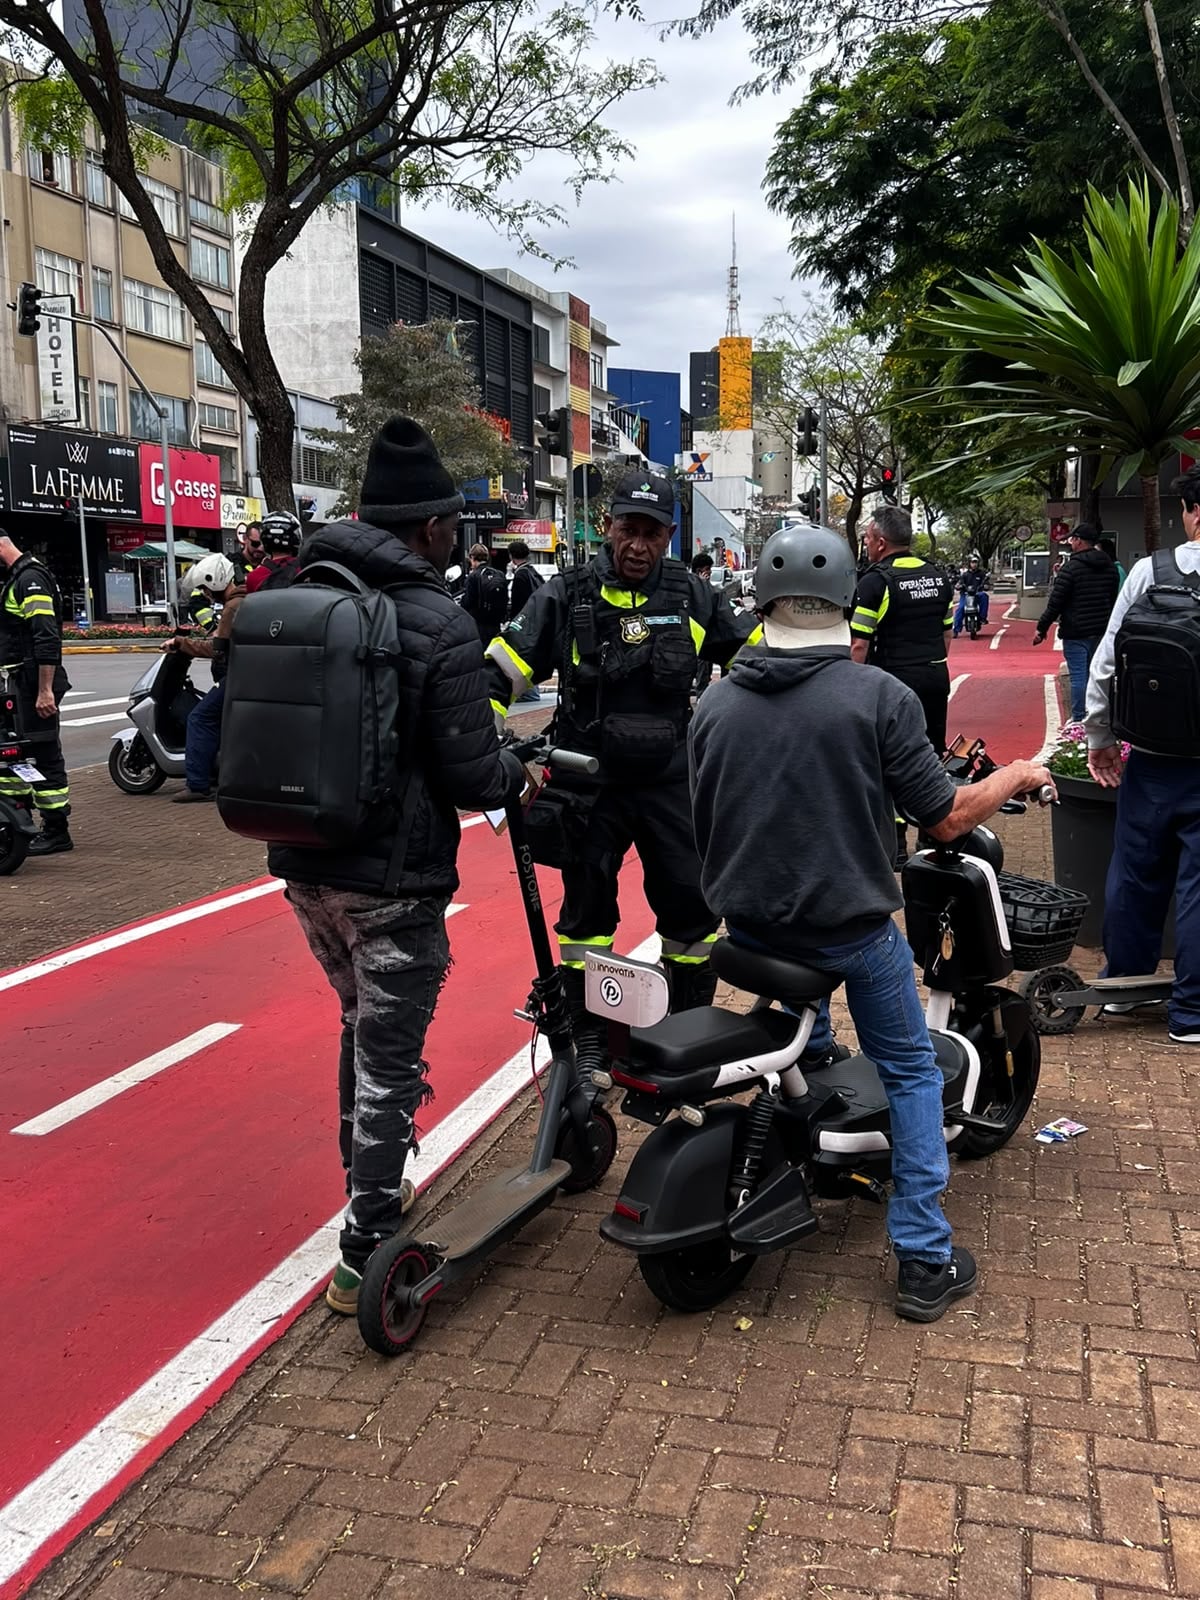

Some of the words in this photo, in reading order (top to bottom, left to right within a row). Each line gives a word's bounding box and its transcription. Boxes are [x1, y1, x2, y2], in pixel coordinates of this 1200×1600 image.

[48, 318, 64, 405] HOTEL
[175, 479, 217, 499] cases
[222, 503, 257, 521] Premier
[899, 576, 935, 590] OPERAÇÕES
[936, 577, 944, 586] DE
